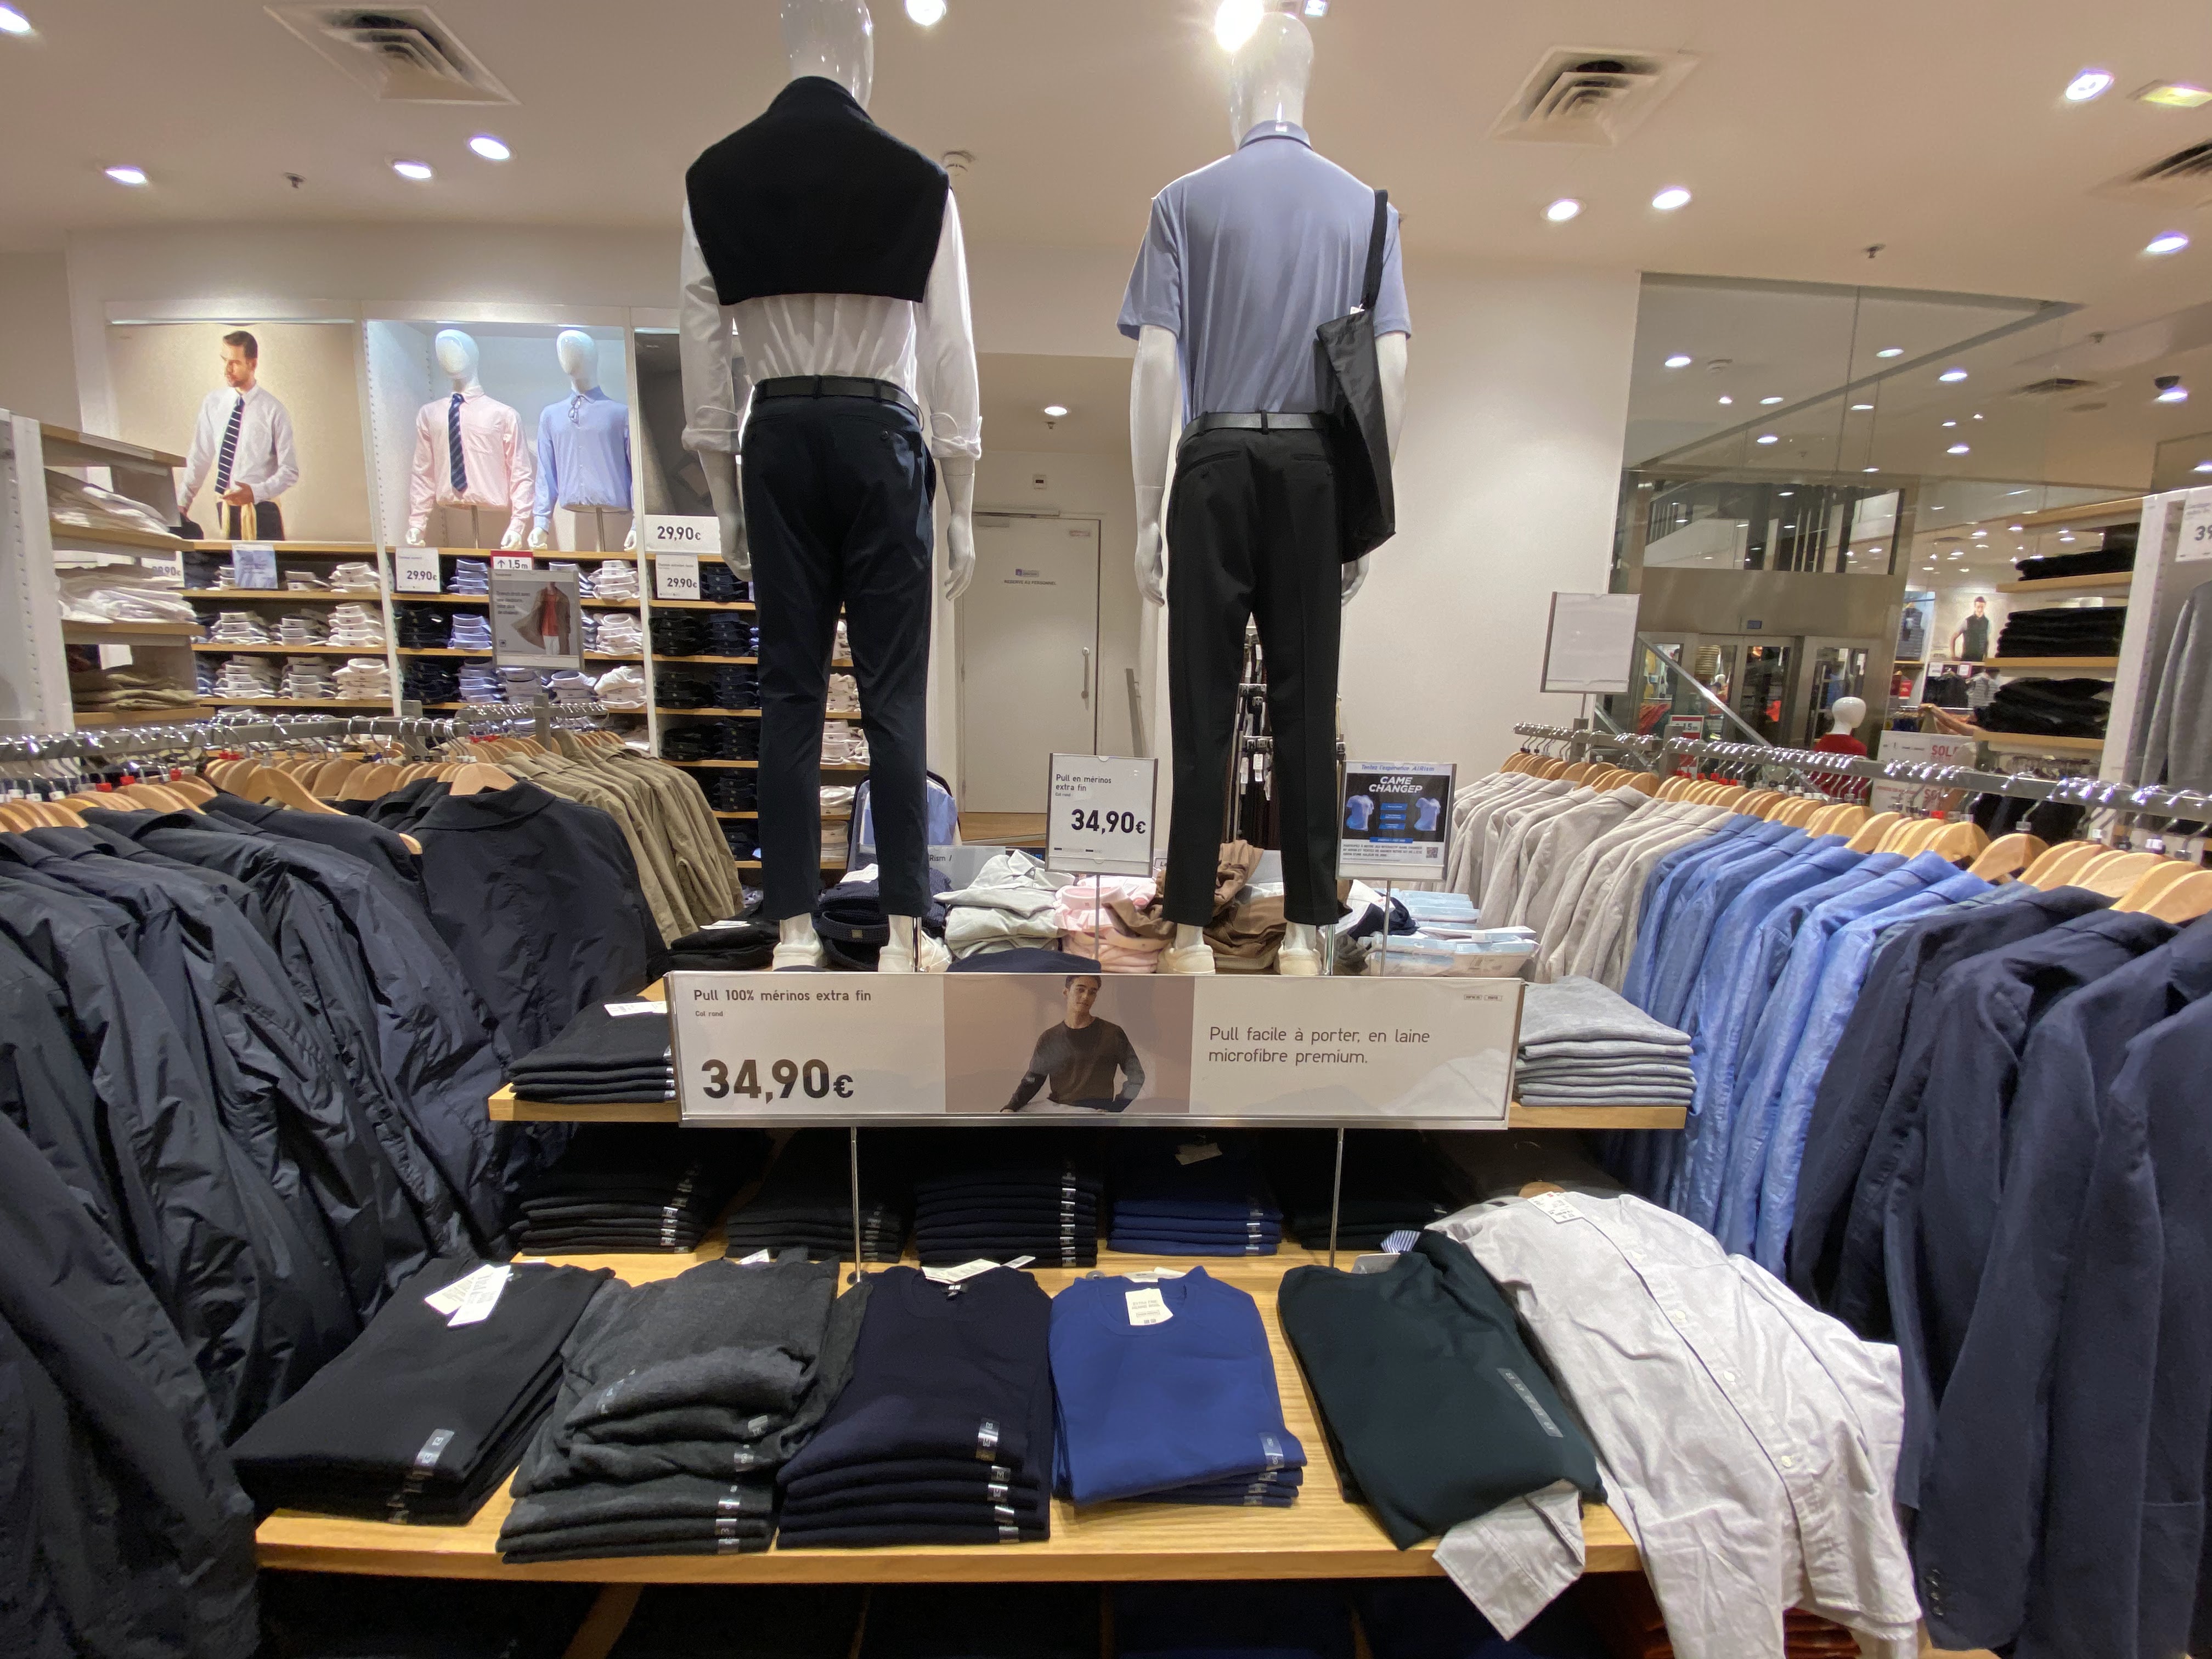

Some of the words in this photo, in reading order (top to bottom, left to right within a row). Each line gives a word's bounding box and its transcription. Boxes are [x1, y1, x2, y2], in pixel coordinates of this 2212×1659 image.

[657, 526, 701, 541] 29,90€
[407, 570, 437, 581] 29,90€
[667, 577, 697, 588] 29,90€
[1056, 774, 1070, 782] Pull
[1084, 775, 1112, 784] mérinos
[1056, 783, 1075, 791] extra
[1077, 783, 1087, 792] fin
[1071, 808, 1147, 835] 34,90€
[693, 989, 719, 1001] Pull
[725, 989, 755, 1001] 100%
[760, 989, 810, 1001] mérinos
[816, 990, 850, 1001] extra
[855, 990, 872, 1001] fin
[1209, 1026, 1239, 1041] Pull
[1246, 1026, 1287, 1041] facile
[1294, 1027, 1304, 1042] à
[1311, 1028, 1361, 1046] porter,
[1368, 1031, 1387, 1043] en
[1395, 1029, 1431, 1043] laine
[1208, 1048, 1288, 1063] microfibre
[1295, 1048, 1368, 1066] premium.
[701, 1059, 854, 1104] 34,90€
